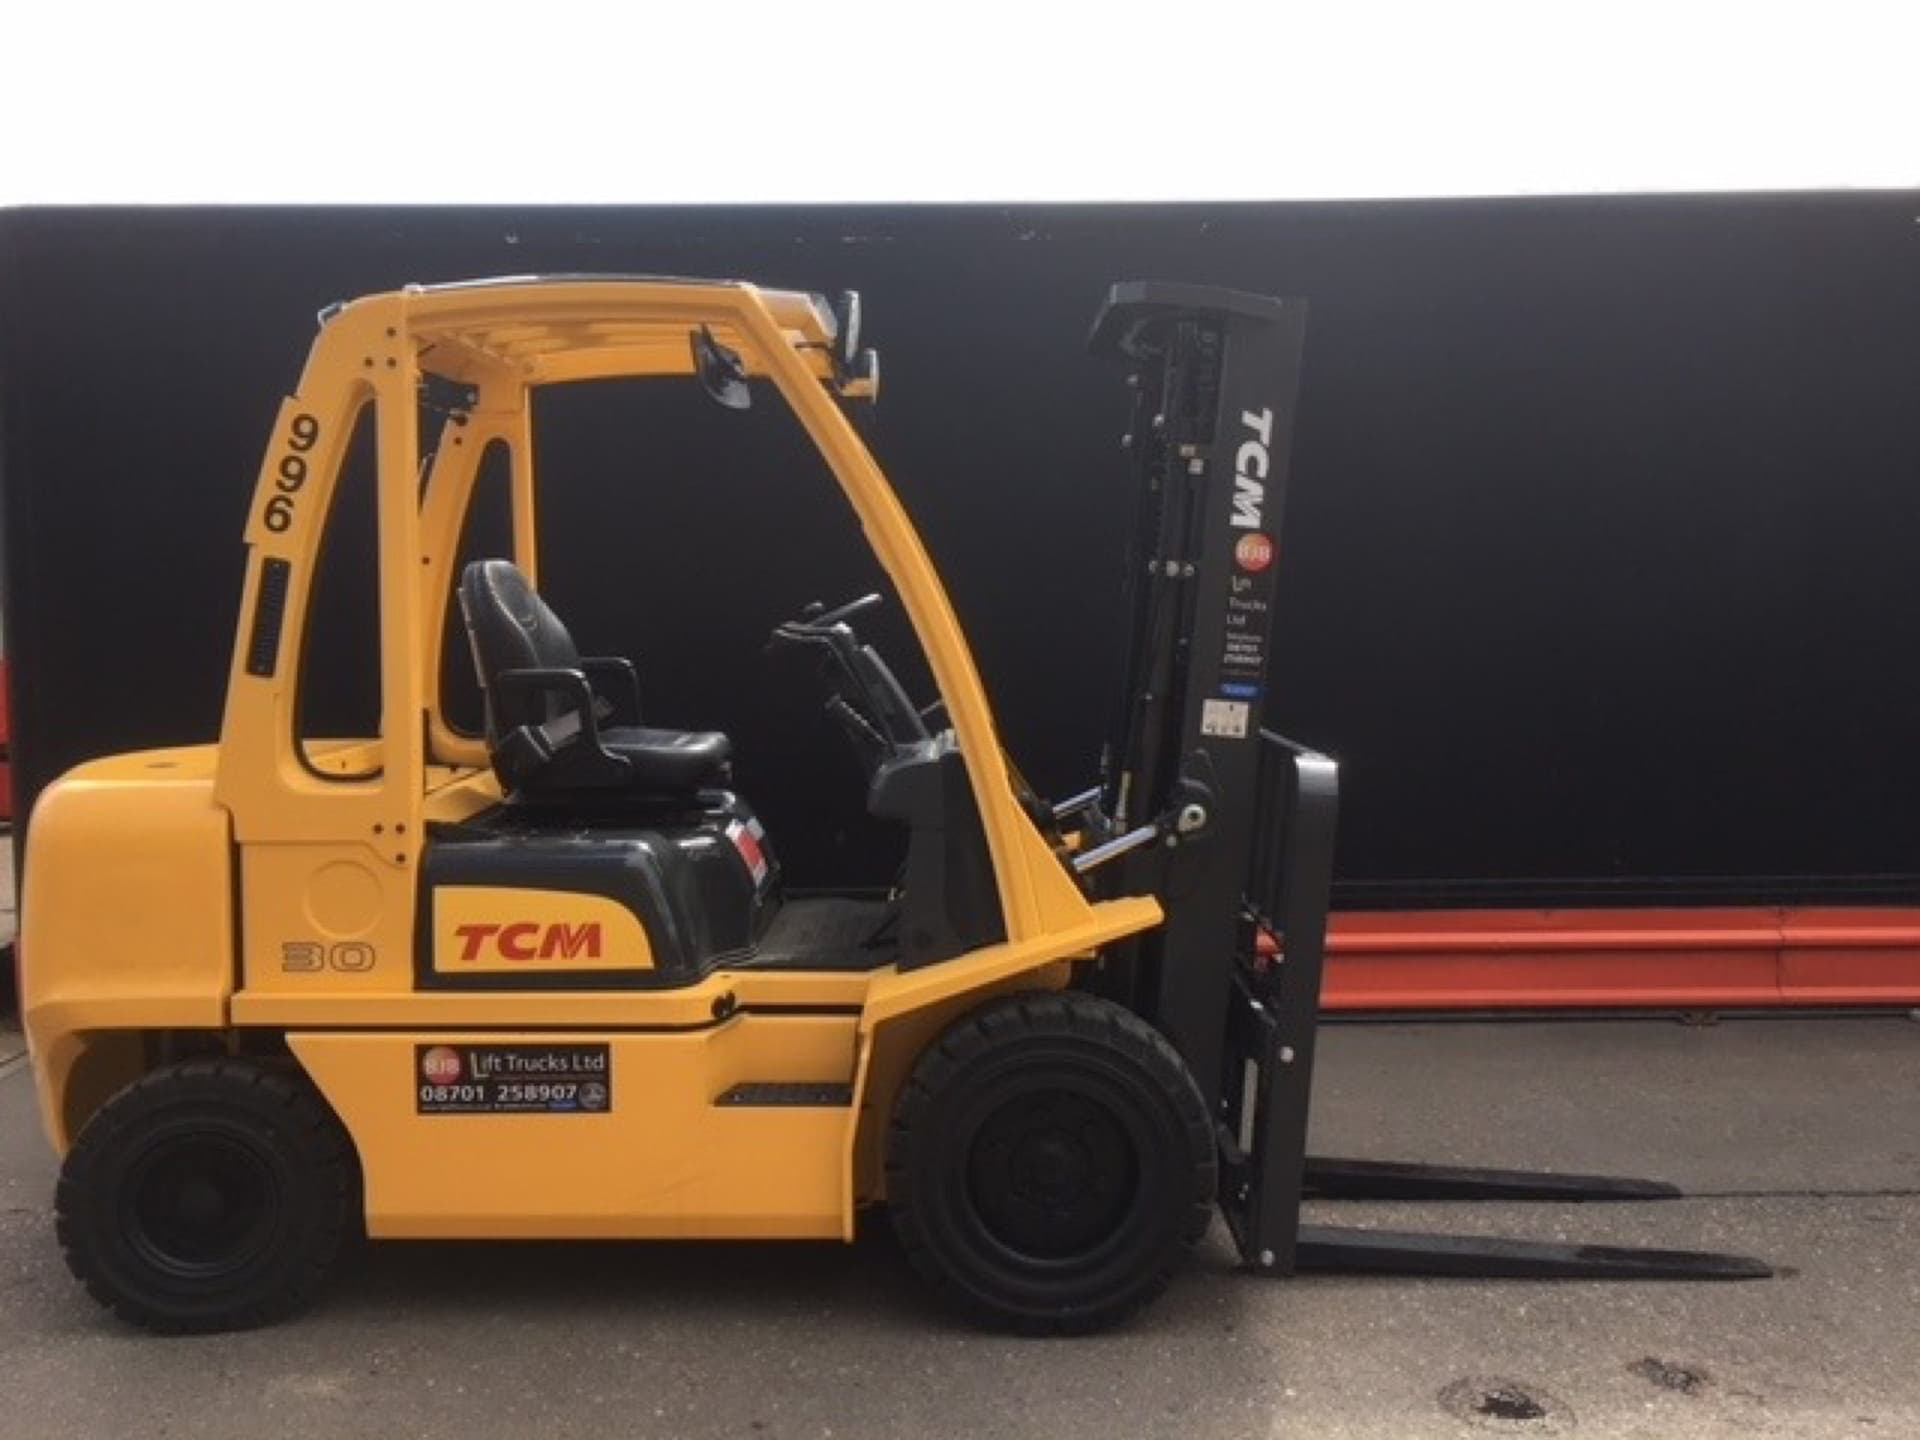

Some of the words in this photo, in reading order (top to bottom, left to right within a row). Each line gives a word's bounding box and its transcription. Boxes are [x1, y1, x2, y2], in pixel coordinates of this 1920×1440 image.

[264, 413, 319, 534] 996
[1229, 407, 1273, 528] TCM
[281, 941, 376, 973] 30
[453, 922, 601, 961] TCM
[507, 1054, 569, 1073] Trucks
[572, 1053, 605, 1072] Ltd
[420, 1085, 485, 1103] 08701
[497, 1085, 578, 1103] 258907
